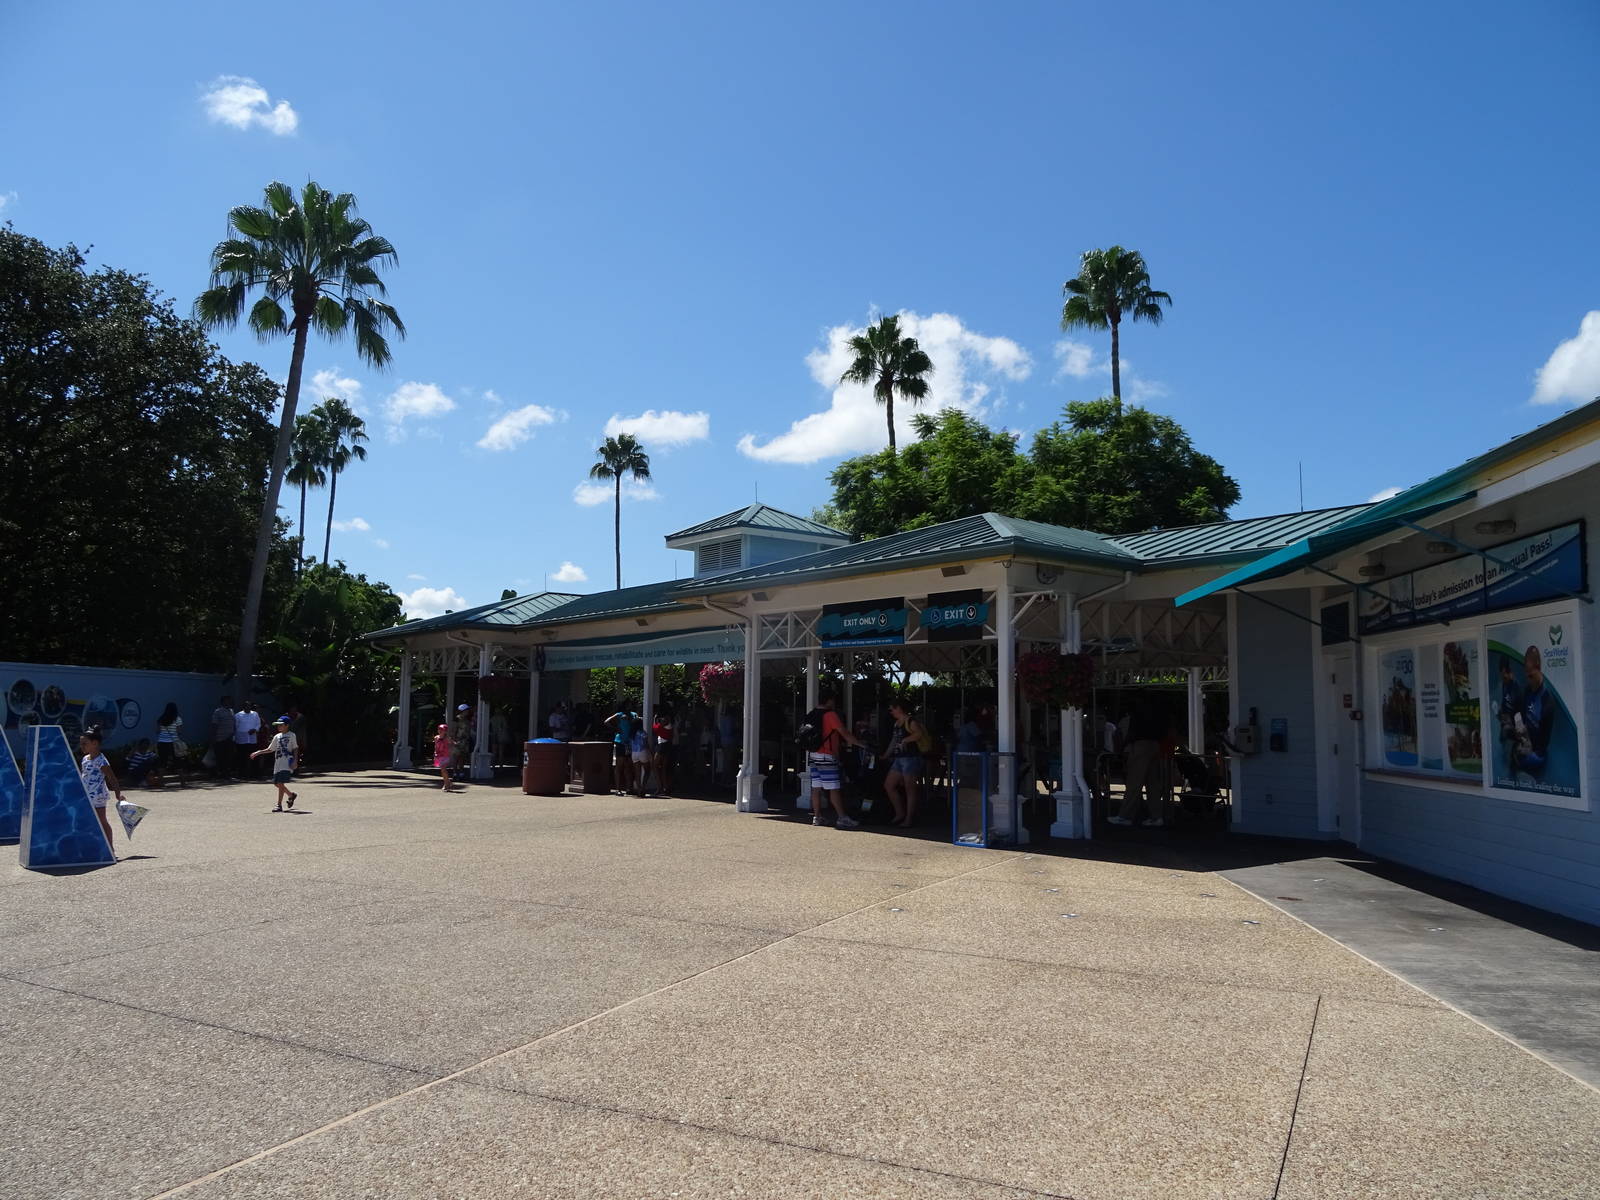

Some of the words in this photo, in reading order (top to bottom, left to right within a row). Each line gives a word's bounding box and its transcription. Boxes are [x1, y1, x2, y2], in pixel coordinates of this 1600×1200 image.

[1415, 589, 1437, 607] today's
[1438, 578, 1473, 600] admission
[1474, 572, 1483, 585] to
[1487, 566, 1497, 581] an
[1530, 536, 1553, 558] Pass!
[944, 609, 964, 620] EXIT
[843, 618, 858, 627] EXIT
[859, 616, 876, 626] ONLY
[716, 643, 736, 654] Thank
[737, 645, 746, 656] yo
[1543, 646, 1568, 657] SeaWorld
